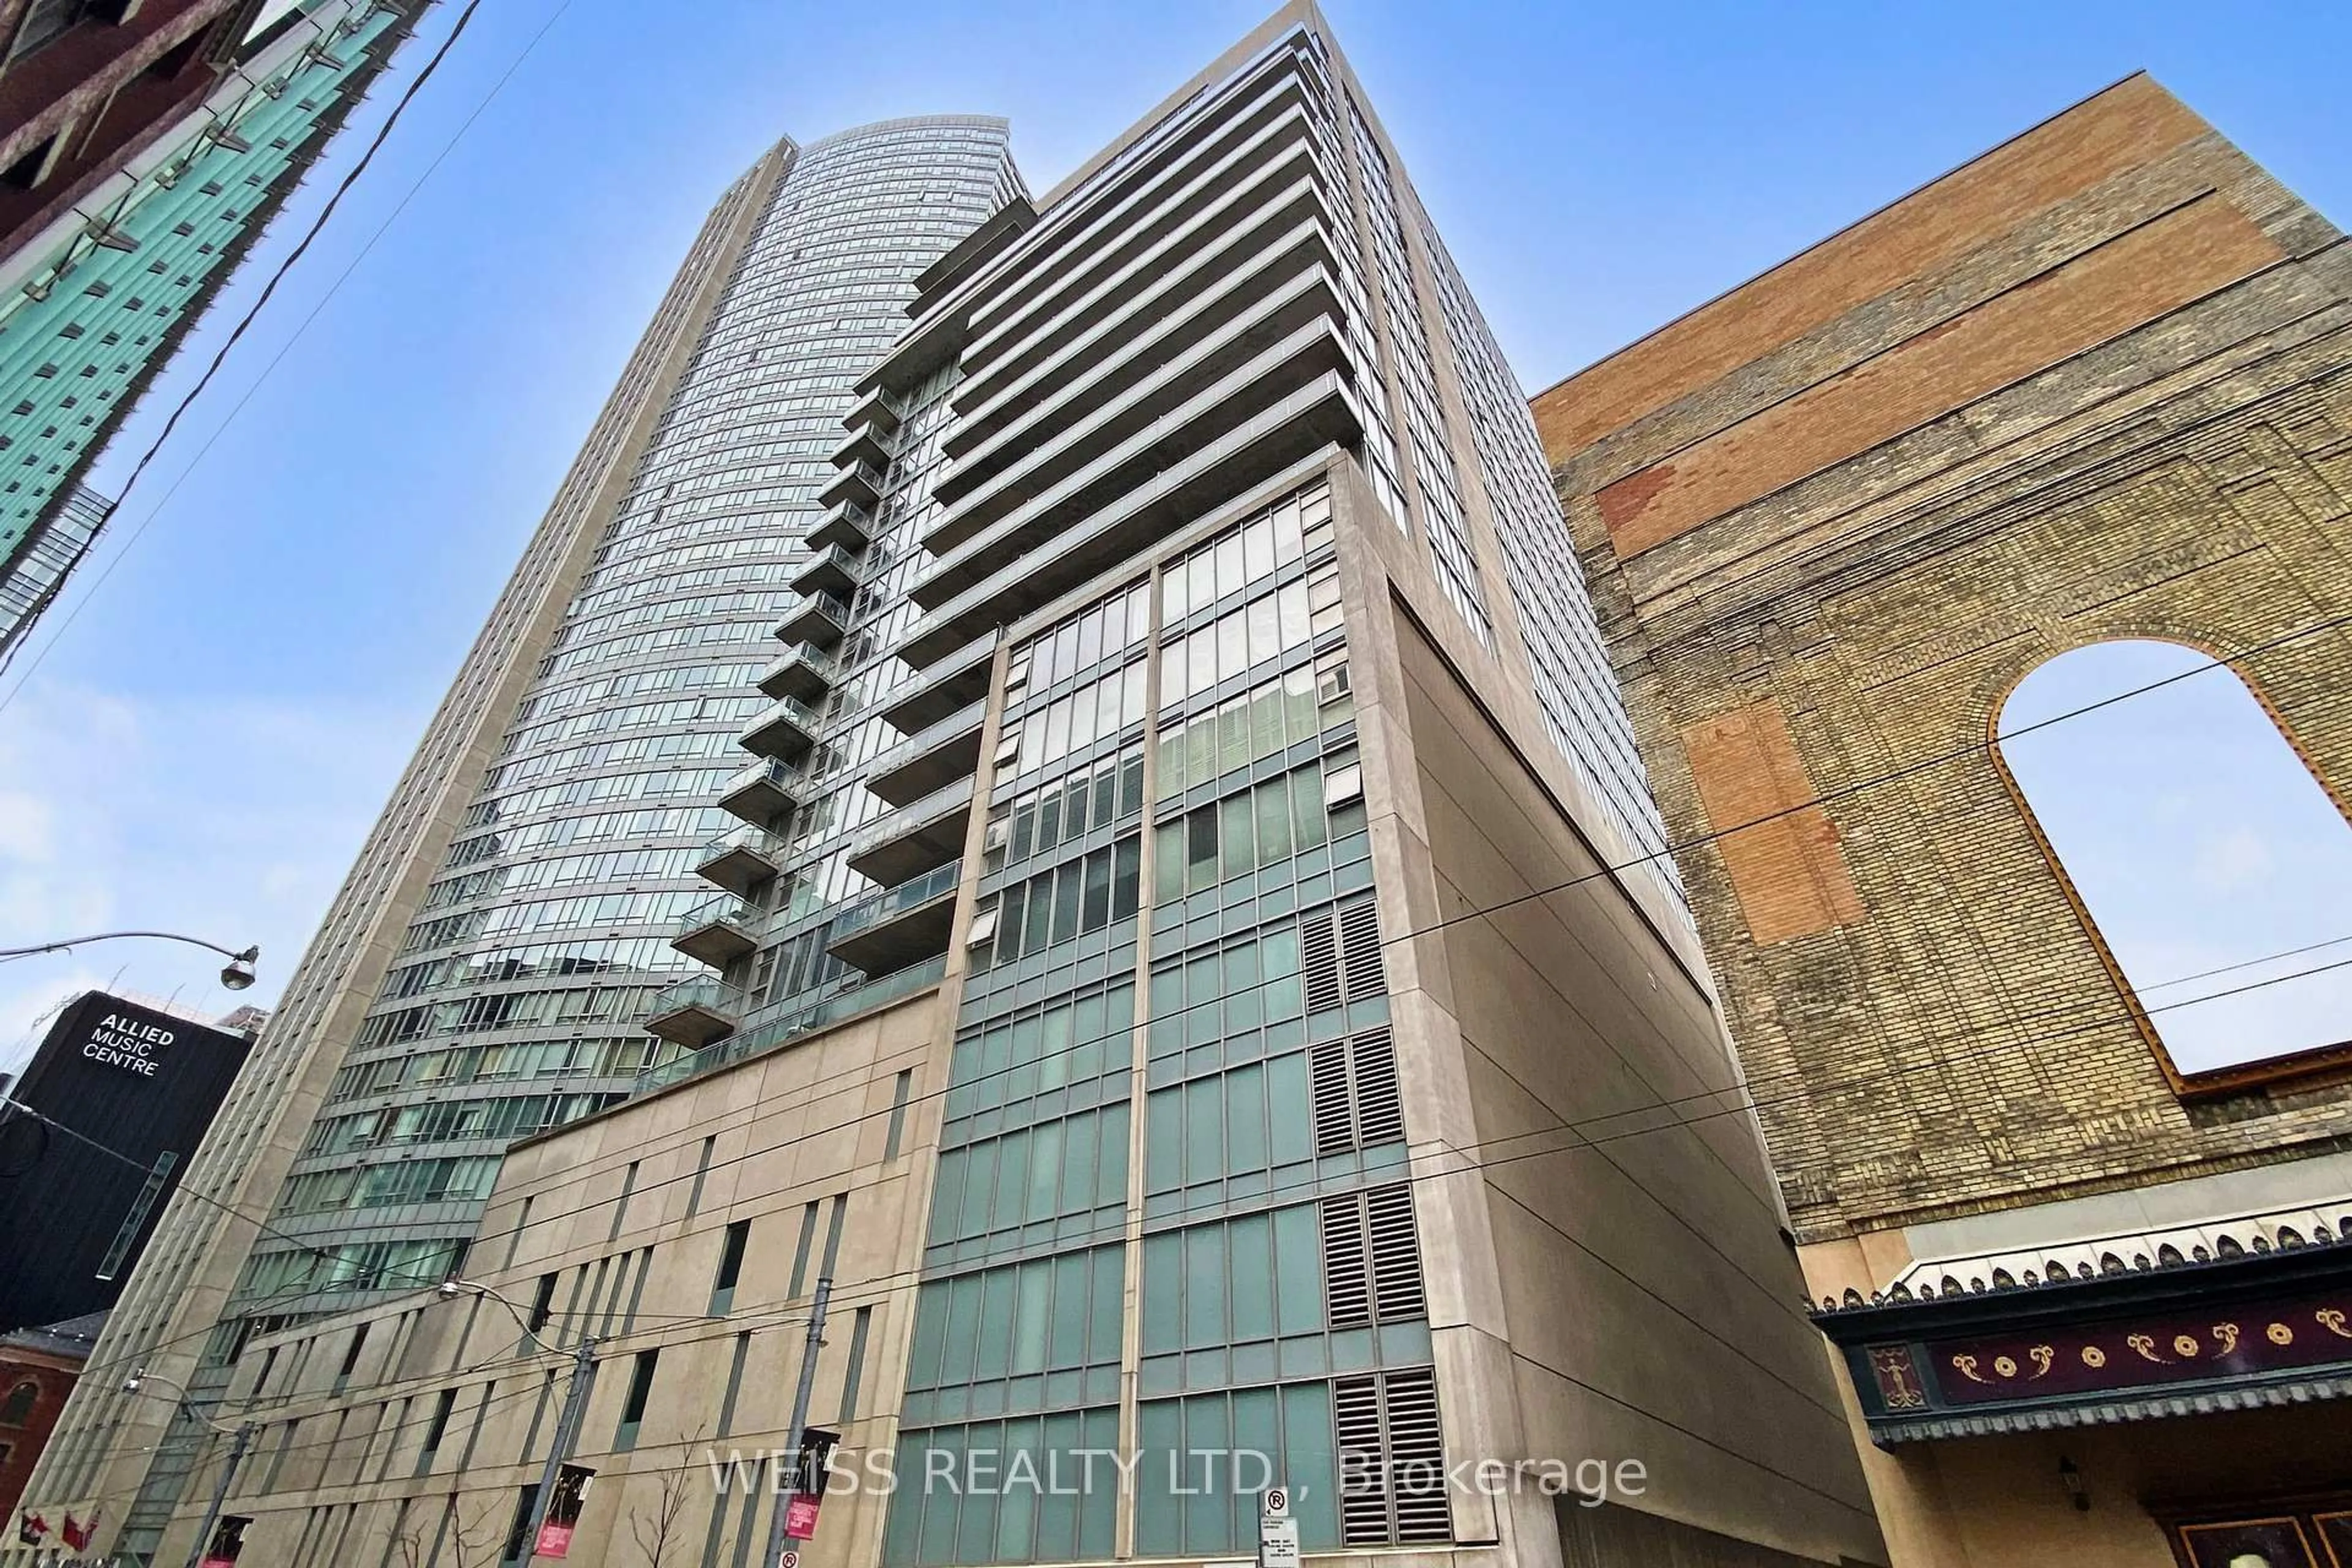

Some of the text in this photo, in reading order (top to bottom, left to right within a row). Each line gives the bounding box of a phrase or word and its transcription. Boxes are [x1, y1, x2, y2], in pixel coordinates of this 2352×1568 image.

[91, 1027, 153, 1057] MUSIC
[100, 1014, 174, 1046] ALLIED
[83, 1043, 159, 1076] CENTRE
